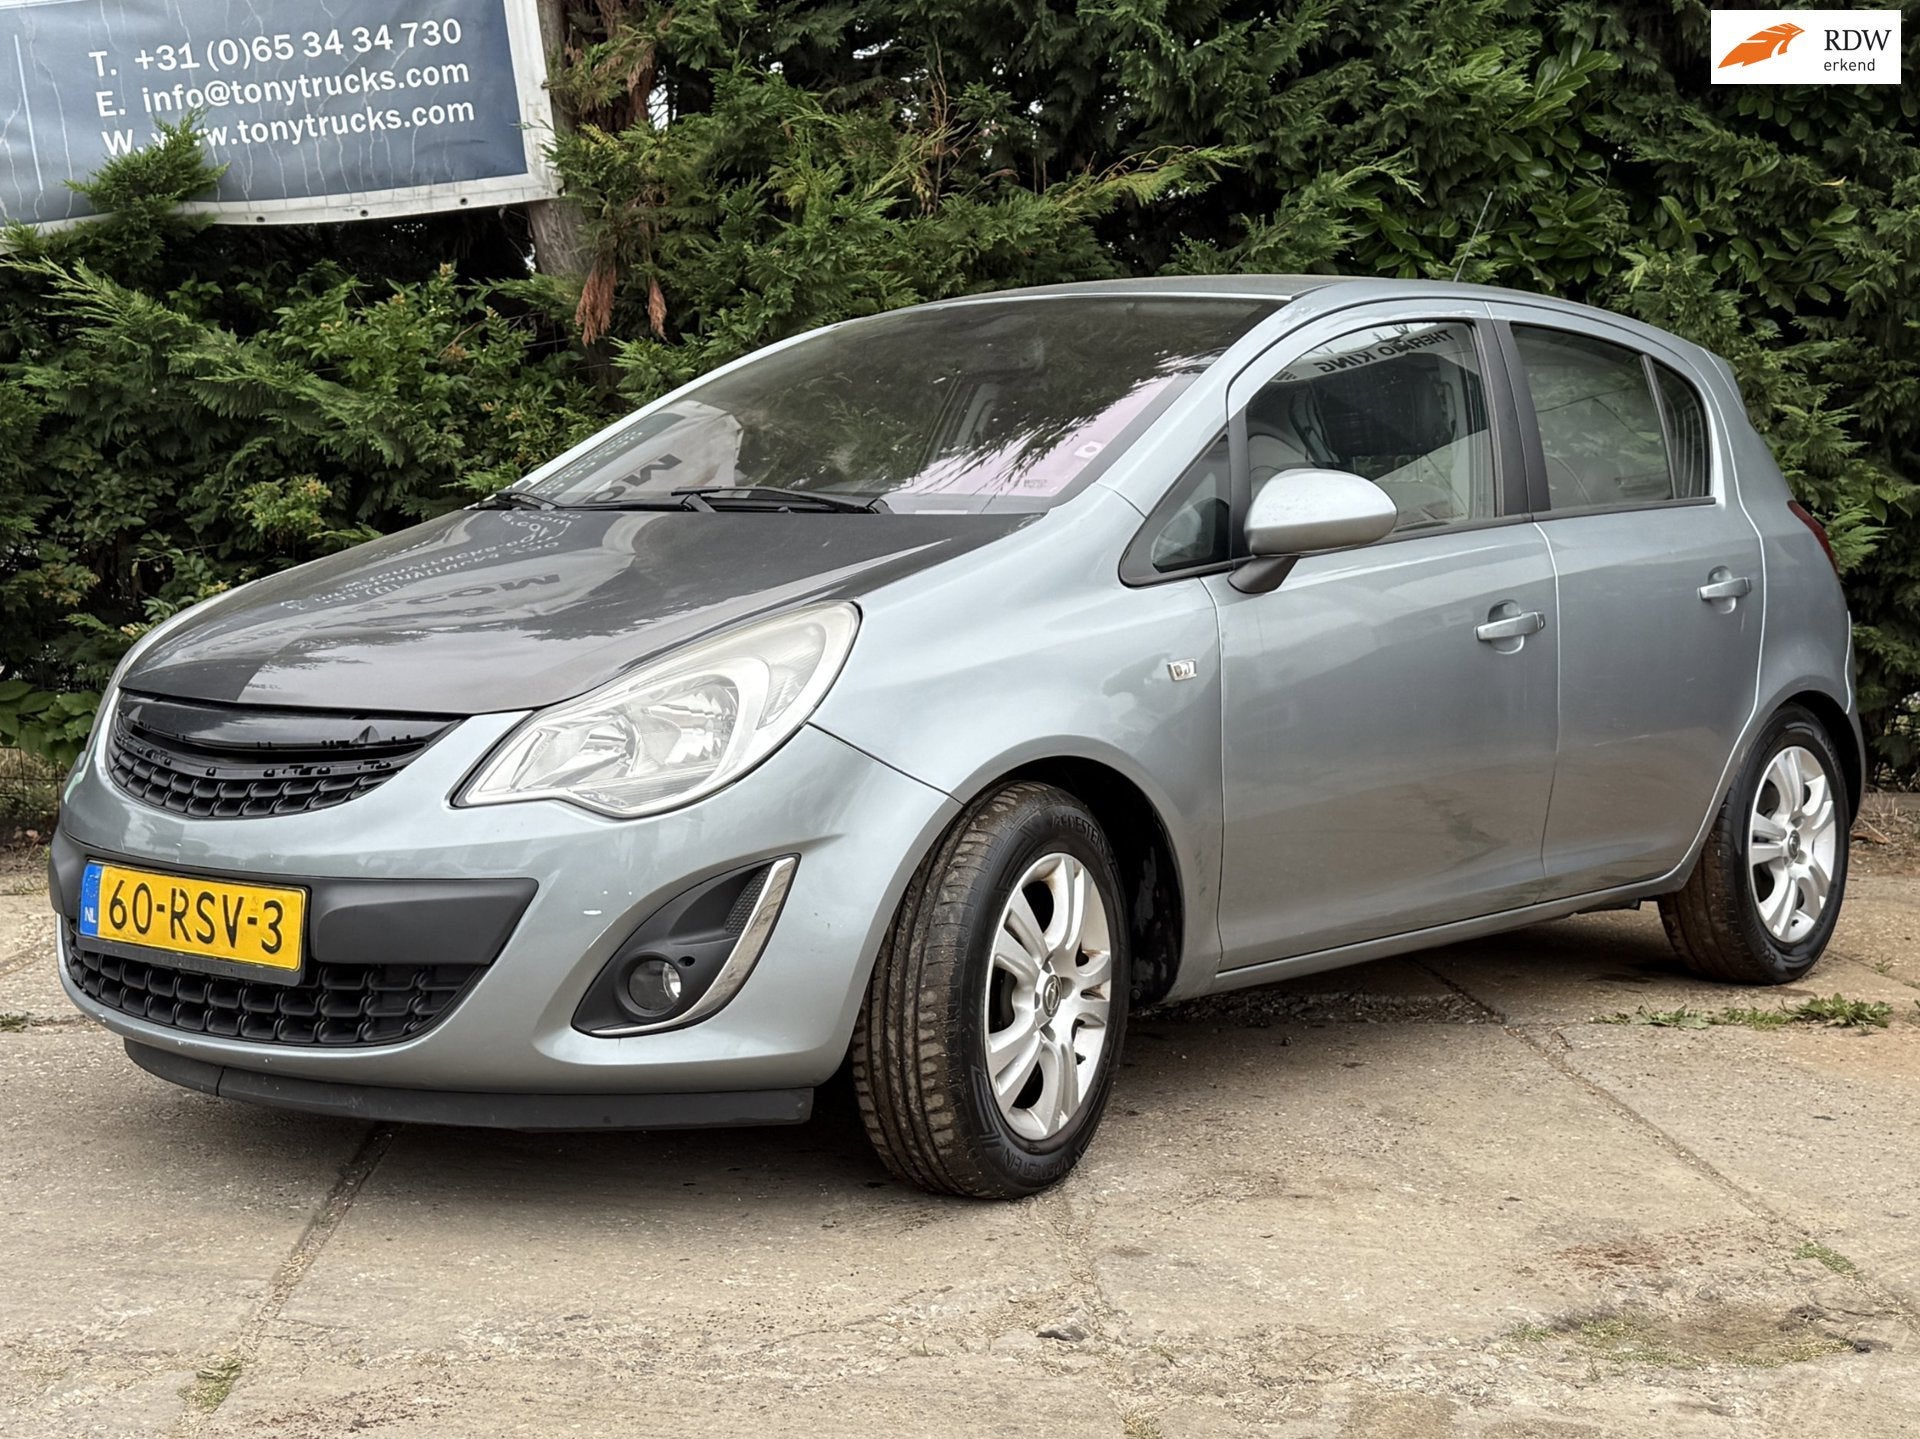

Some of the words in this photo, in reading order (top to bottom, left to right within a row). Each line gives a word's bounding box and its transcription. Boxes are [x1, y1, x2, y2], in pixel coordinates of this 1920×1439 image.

[88, 50, 118, 77] T.
[134, 42, 201, 71] +31
[206, 34, 294, 72] (0)65
[302, 29, 344, 58] 34
[351, 24, 394, 53] 34
[400, 18, 462, 48] 730
[95, 90, 126, 117] E.
[141, 62, 470, 113] info@tonytrucks.com
[101, 129, 144, 156] W.
[151, 101, 475, 151] ww.tonytrucks.com
[84, 907, 97, 924] NL
[109, 880, 283, 953] 60-RSV-3
